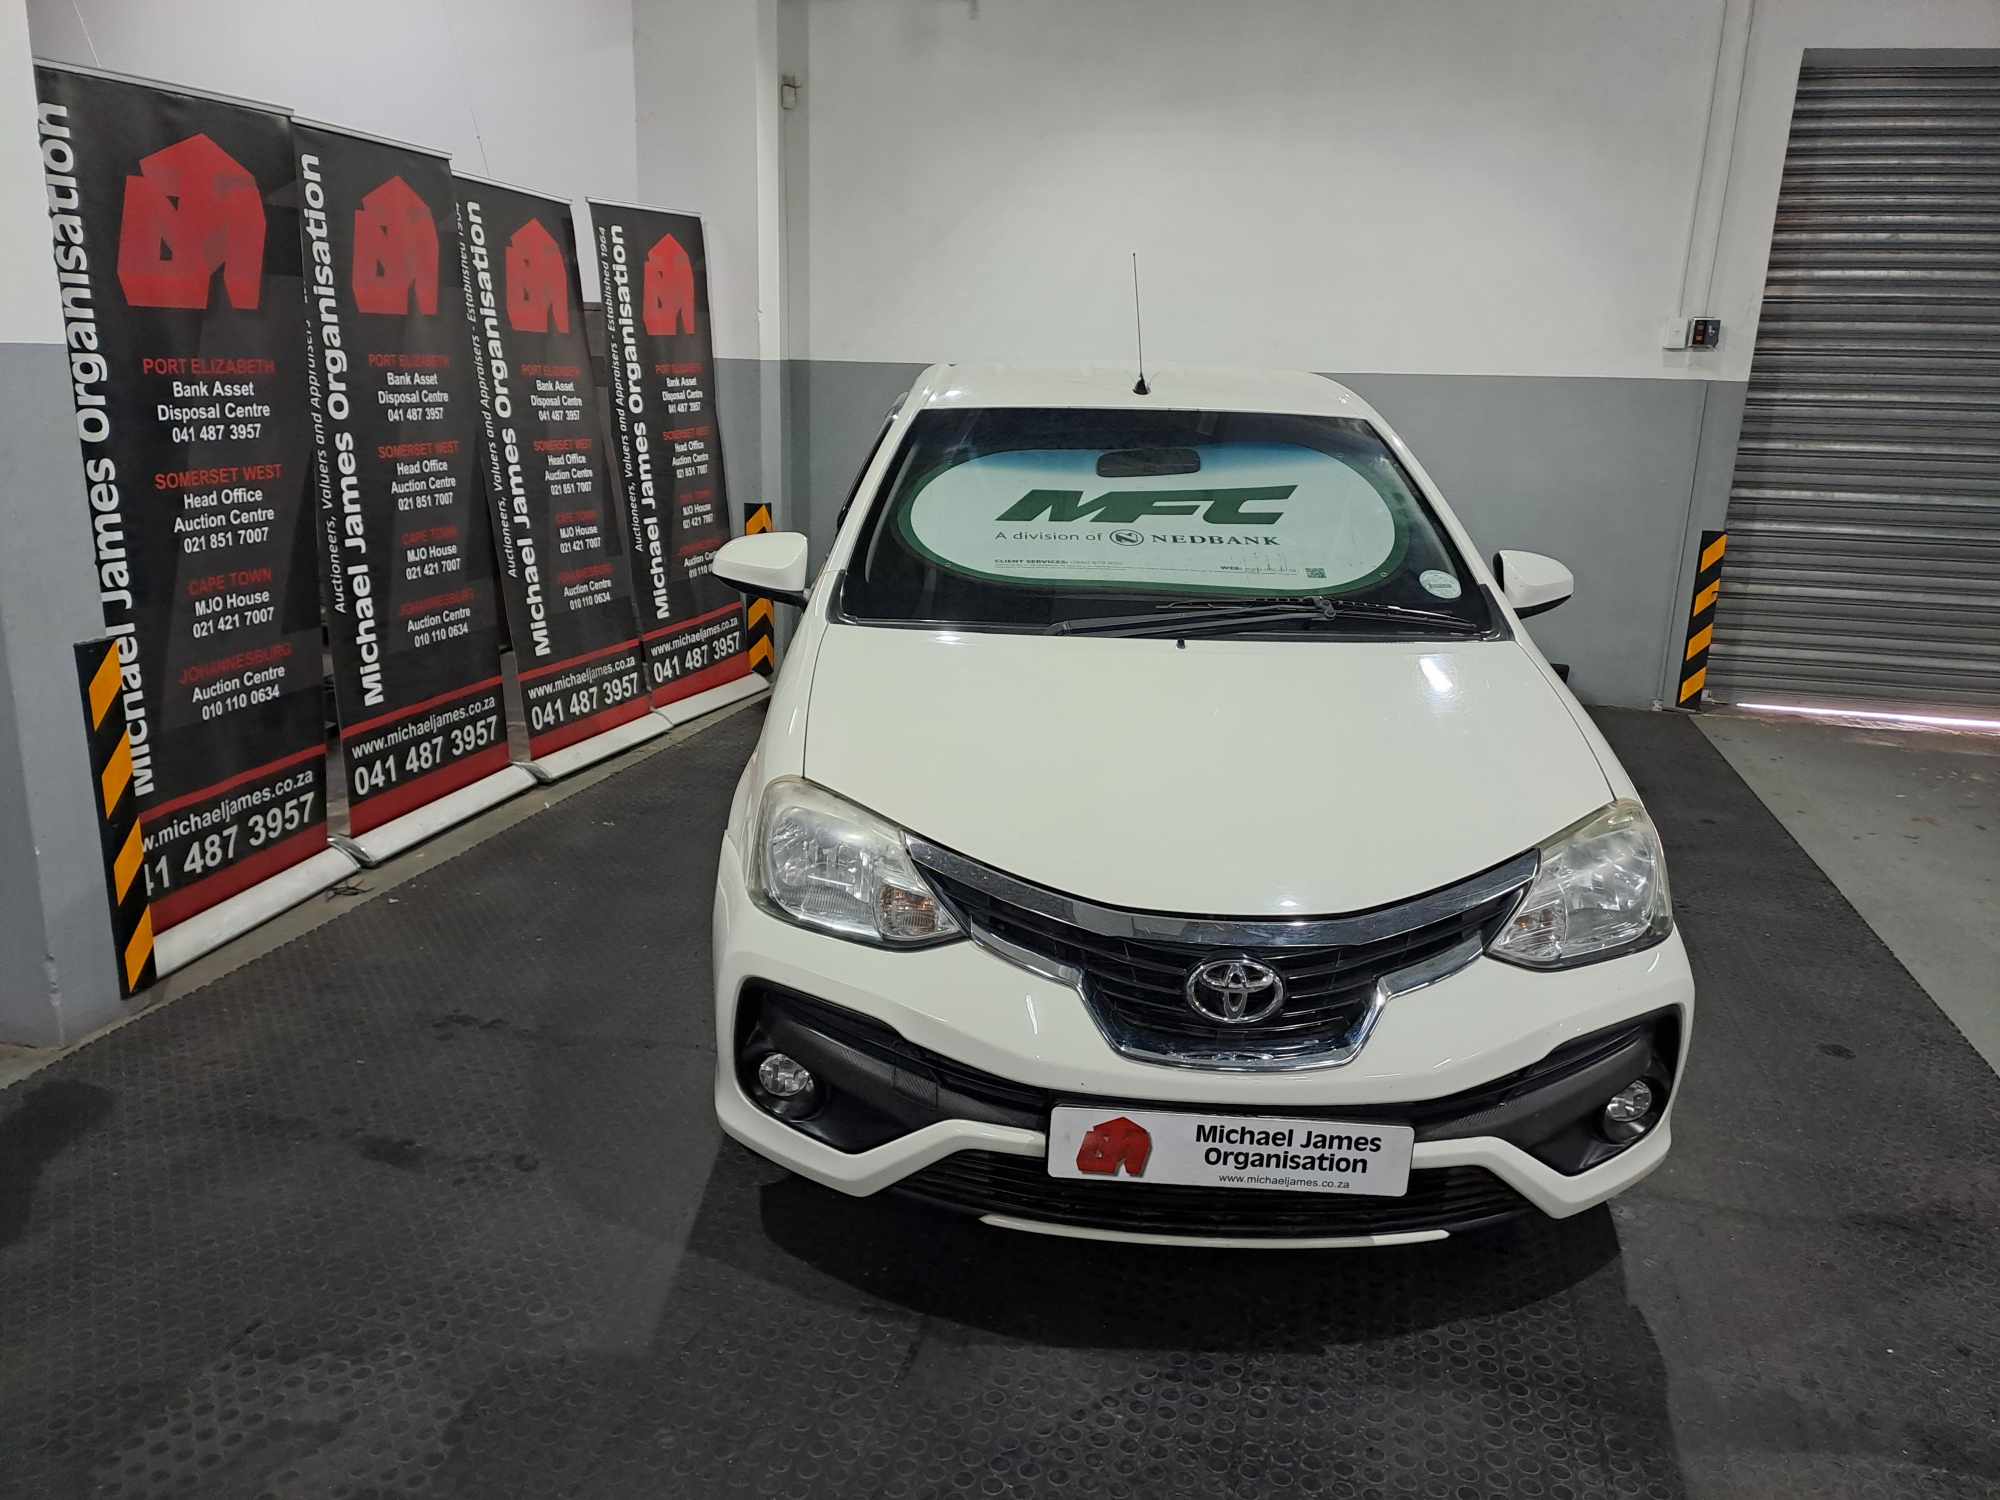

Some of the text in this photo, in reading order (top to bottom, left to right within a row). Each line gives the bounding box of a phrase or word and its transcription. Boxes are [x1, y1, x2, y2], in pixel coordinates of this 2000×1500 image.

[602, 261, 616, 332] Established
[143, 358, 276, 375] PORT ELIZABETH
[386, 372, 438, 385] Bank Asset
[472, 335, 489, 411] Appraisers
[611, 343, 626, 408] Appraisers
[172, 380, 255, 398] Bank Asset
[377, 389, 449, 406] Disposal Centre
[157, 402, 271, 423] Disposal Centre
[388, 407, 444, 422] 041 487 3957
[480, 413, 494, 438] and
[611, 224, 671, 620] Michael James Organisation
[617, 410, 628, 432] and
[172, 423, 262, 443] 041 487 3957
[301, 153, 384, 707] Michael James Organisation
[310, 411, 326, 445] and
[467, 201, 551, 657] Michael James Organisation
[396, 459, 448, 476] Head Office
[489, 441, 501, 492] Valuers
[622, 437, 634, 478] Valuers
[154, 464, 283, 490] SOMERSET WEST
[320, 448, 333, 510] Valuers
[391, 476, 456, 494] Auction Centre
[544, 469, 571, 482] Auction
[183, 488, 263, 509] Head Office
[398, 492, 454, 511] 021 851 7007
[995, 484, 1299, 525] MFC
[173, 507, 275, 533] Auction Centre
[575, 525, 599, 536] House
[629, 482, 643, 552] Auctioneers,
[86, 458, 133, 610] James
[183, 527, 270, 554] 021 851 7007
[498, 497, 518, 578] Auctioneers,
[572, 539, 584, 551] 421
[995, 531, 1007, 541] A
[1012, 530, 1080, 543] division
[1085, 532, 1104, 543] of
[1152, 533, 1282, 547] NEDBANK
[326, 515, 346, 614] Auctioneers,
[406, 544, 457, 562] MJO House
[188, 568, 272, 596] CAPE TOWN
[406, 558, 461, 580] 021 421 7007
[195, 590, 270, 617] MJO House
[563, 584, 589, 598] Auction
[192, 606, 275, 639] 021 421 7007
[407, 607, 471, 633] Auction Centre
[414, 622, 469, 648] 010 110 0634
[650, 616, 738, 657] www.michaeljames.co.za
[653, 631, 741, 683] 041 487 3957
[191, 665, 286, 703] Auction Centre
[527, 655, 636, 700] www.michaeljames.co.za
[202, 684, 280, 720] 010 110 0634
[531, 671, 639, 731] 041 487 3957
[352, 696, 496, 760] www.michaeljames.co.za
[354, 715, 498, 796] 041 487 3957
[143, 770, 313, 853] w.michaeljames.co.za
[183, 791, 315, 874] 487 3957
[1195, 1124, 1382, 1153] Michael James
[1204, 1147, 1369, 1174] Organisation
[1219, 1174, 1350, 1190] www.michaeljames.co.za
